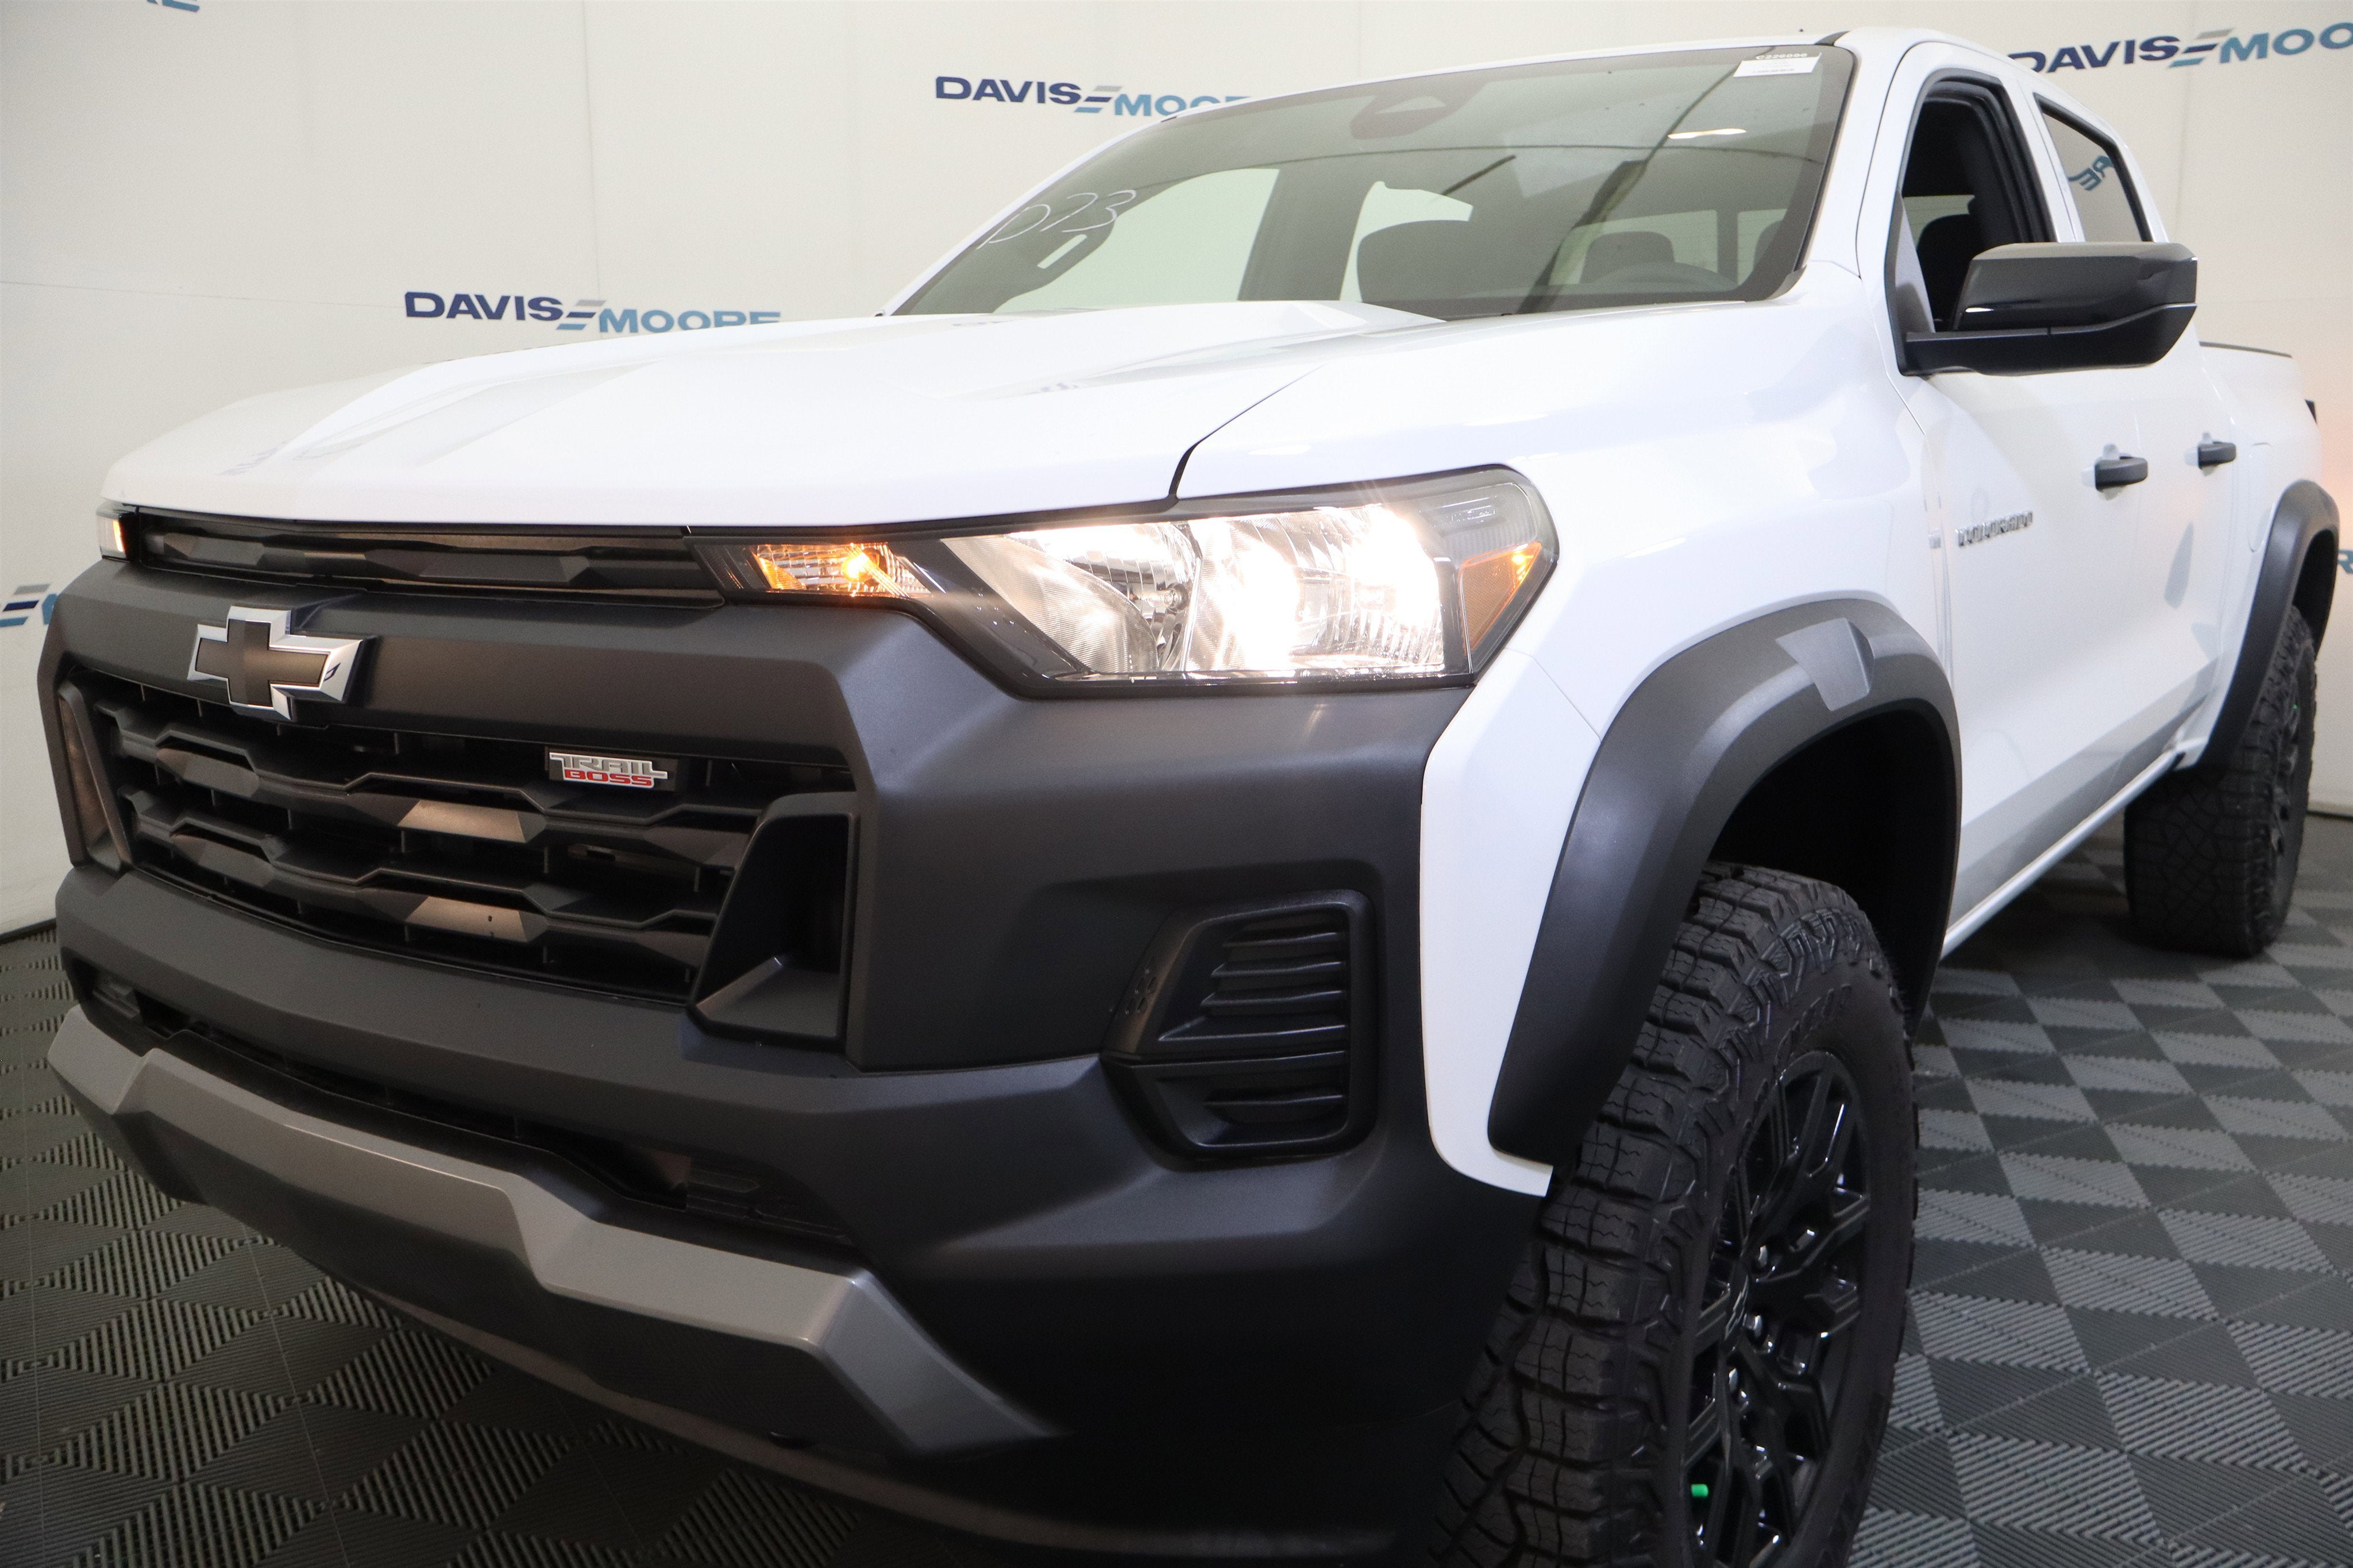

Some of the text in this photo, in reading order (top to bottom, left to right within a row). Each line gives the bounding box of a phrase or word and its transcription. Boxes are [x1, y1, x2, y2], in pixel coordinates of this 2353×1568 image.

[2007, 35, 2181, 74] DAVIS
[936, 76, 1082, 105] DAVIS
[404, 291, 565, 321] DAVIS
[549, 752, 668, 779] TRAIL
[564, 768, 653, 787] BOSS
